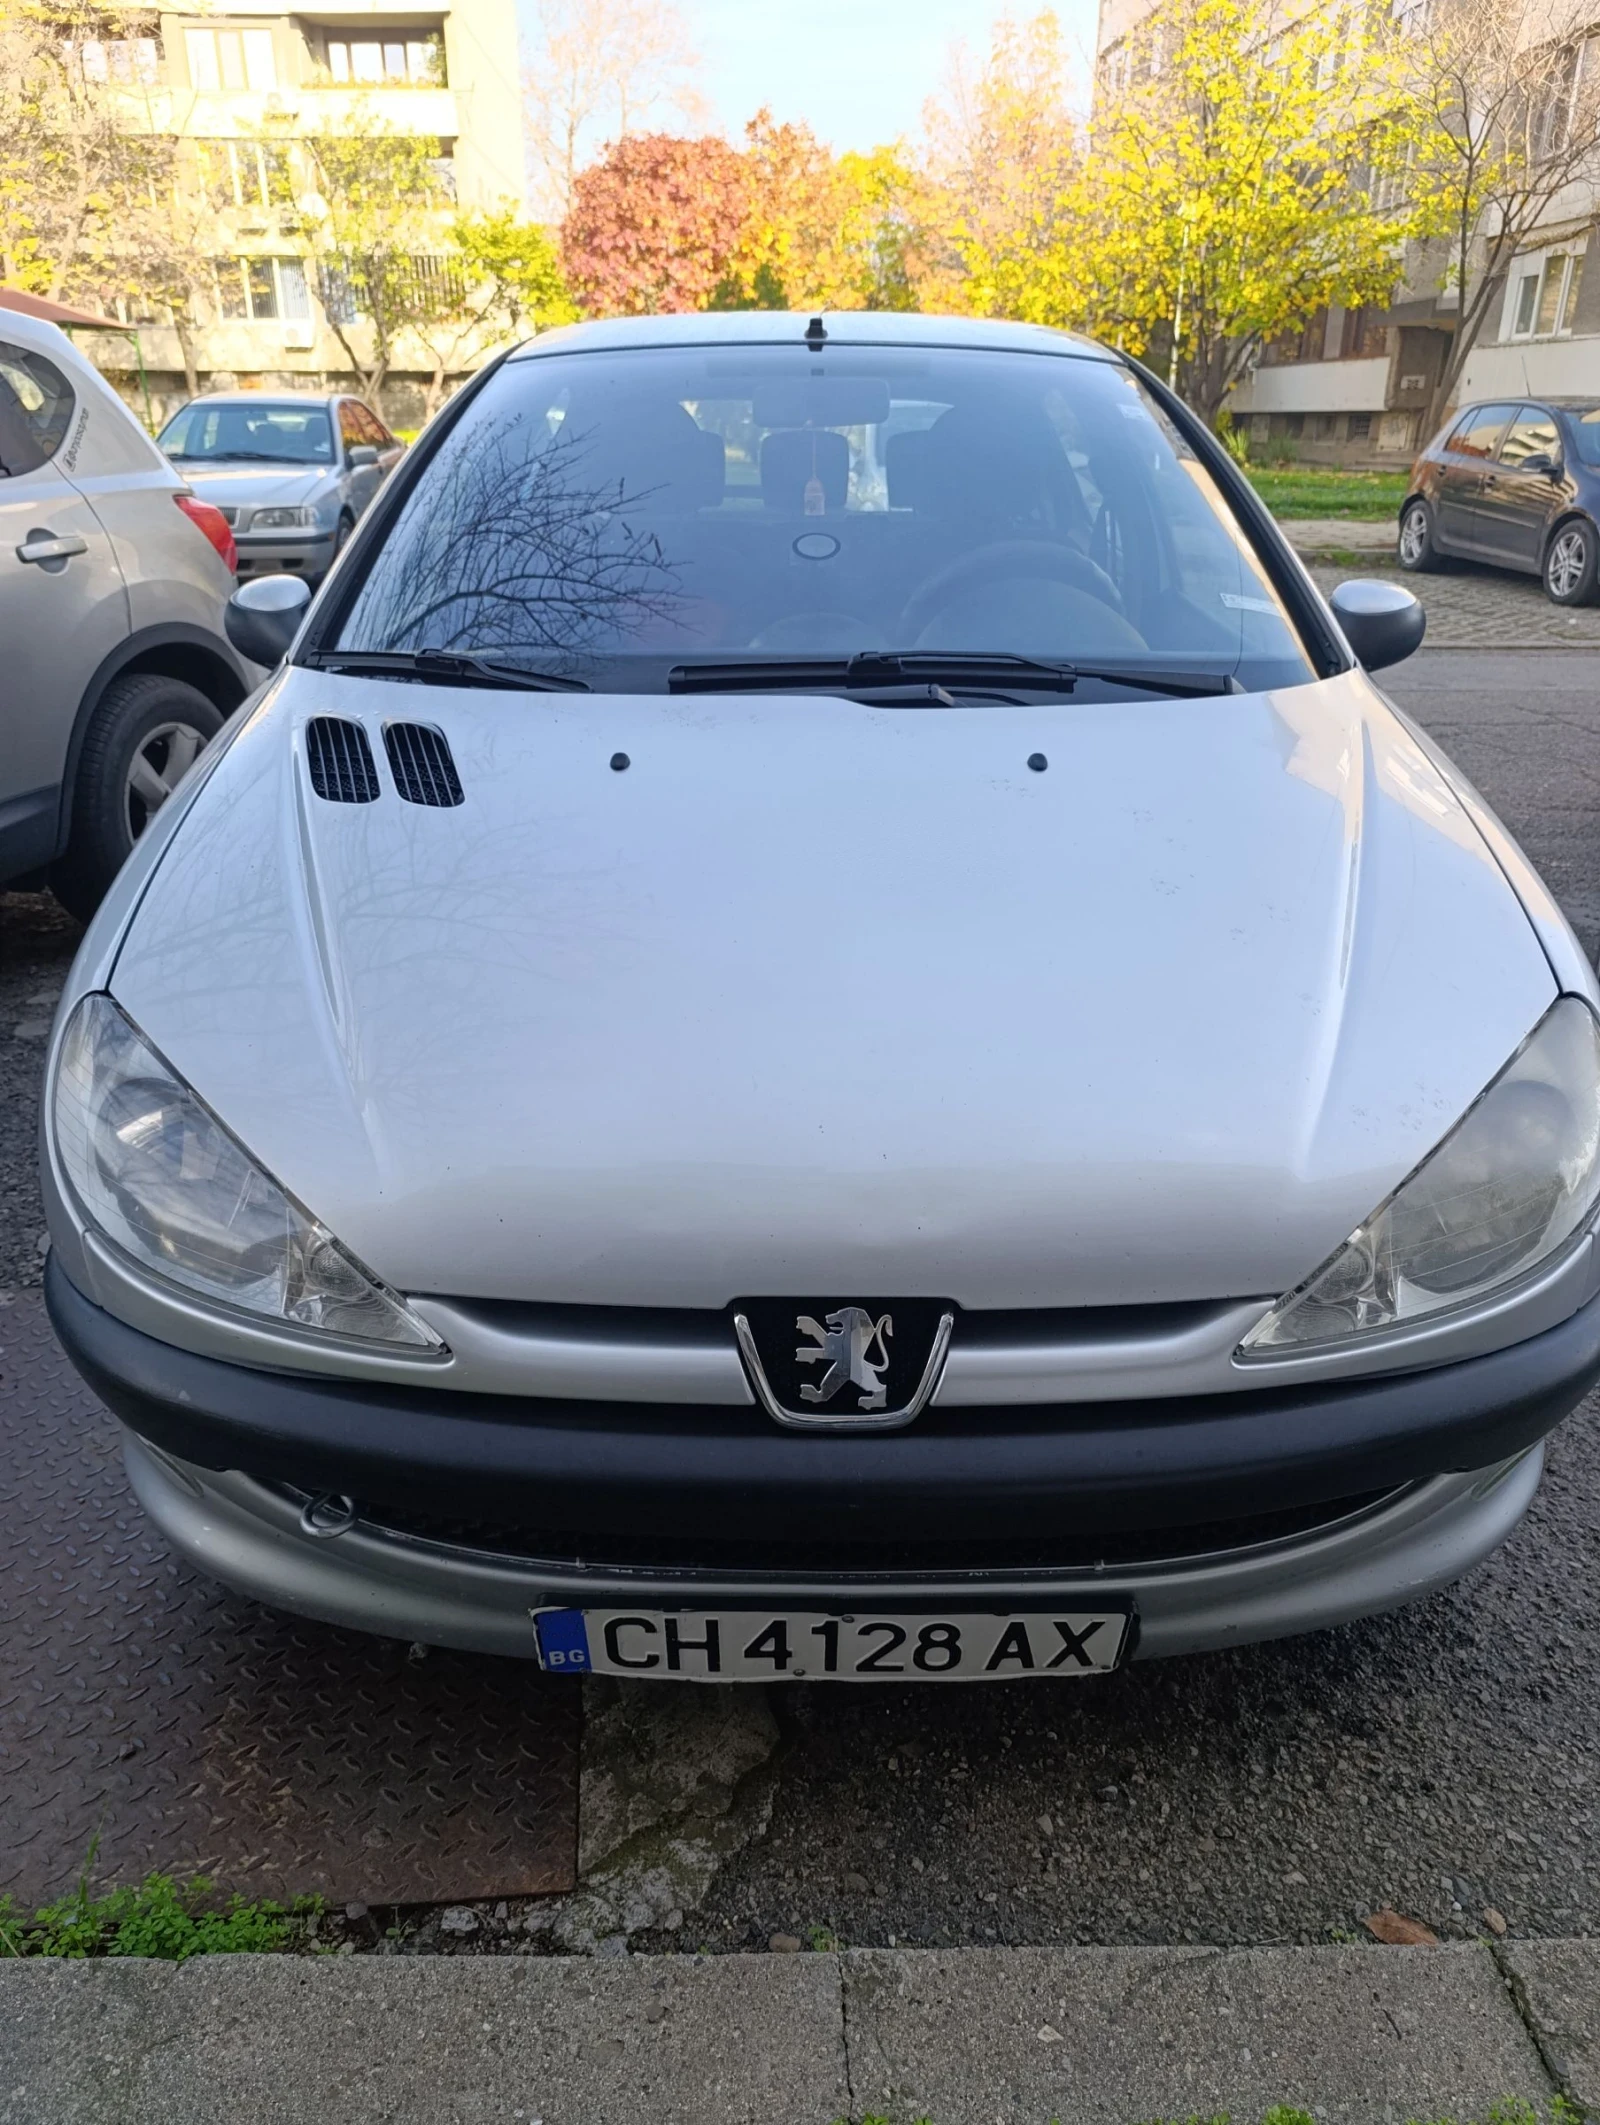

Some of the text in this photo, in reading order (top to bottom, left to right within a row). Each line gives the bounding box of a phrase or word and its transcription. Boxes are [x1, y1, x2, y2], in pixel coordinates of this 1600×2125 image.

[548, 1650, 586, 1666] BG
[603, 1616, 1106, 1673] CH 4128 AX
